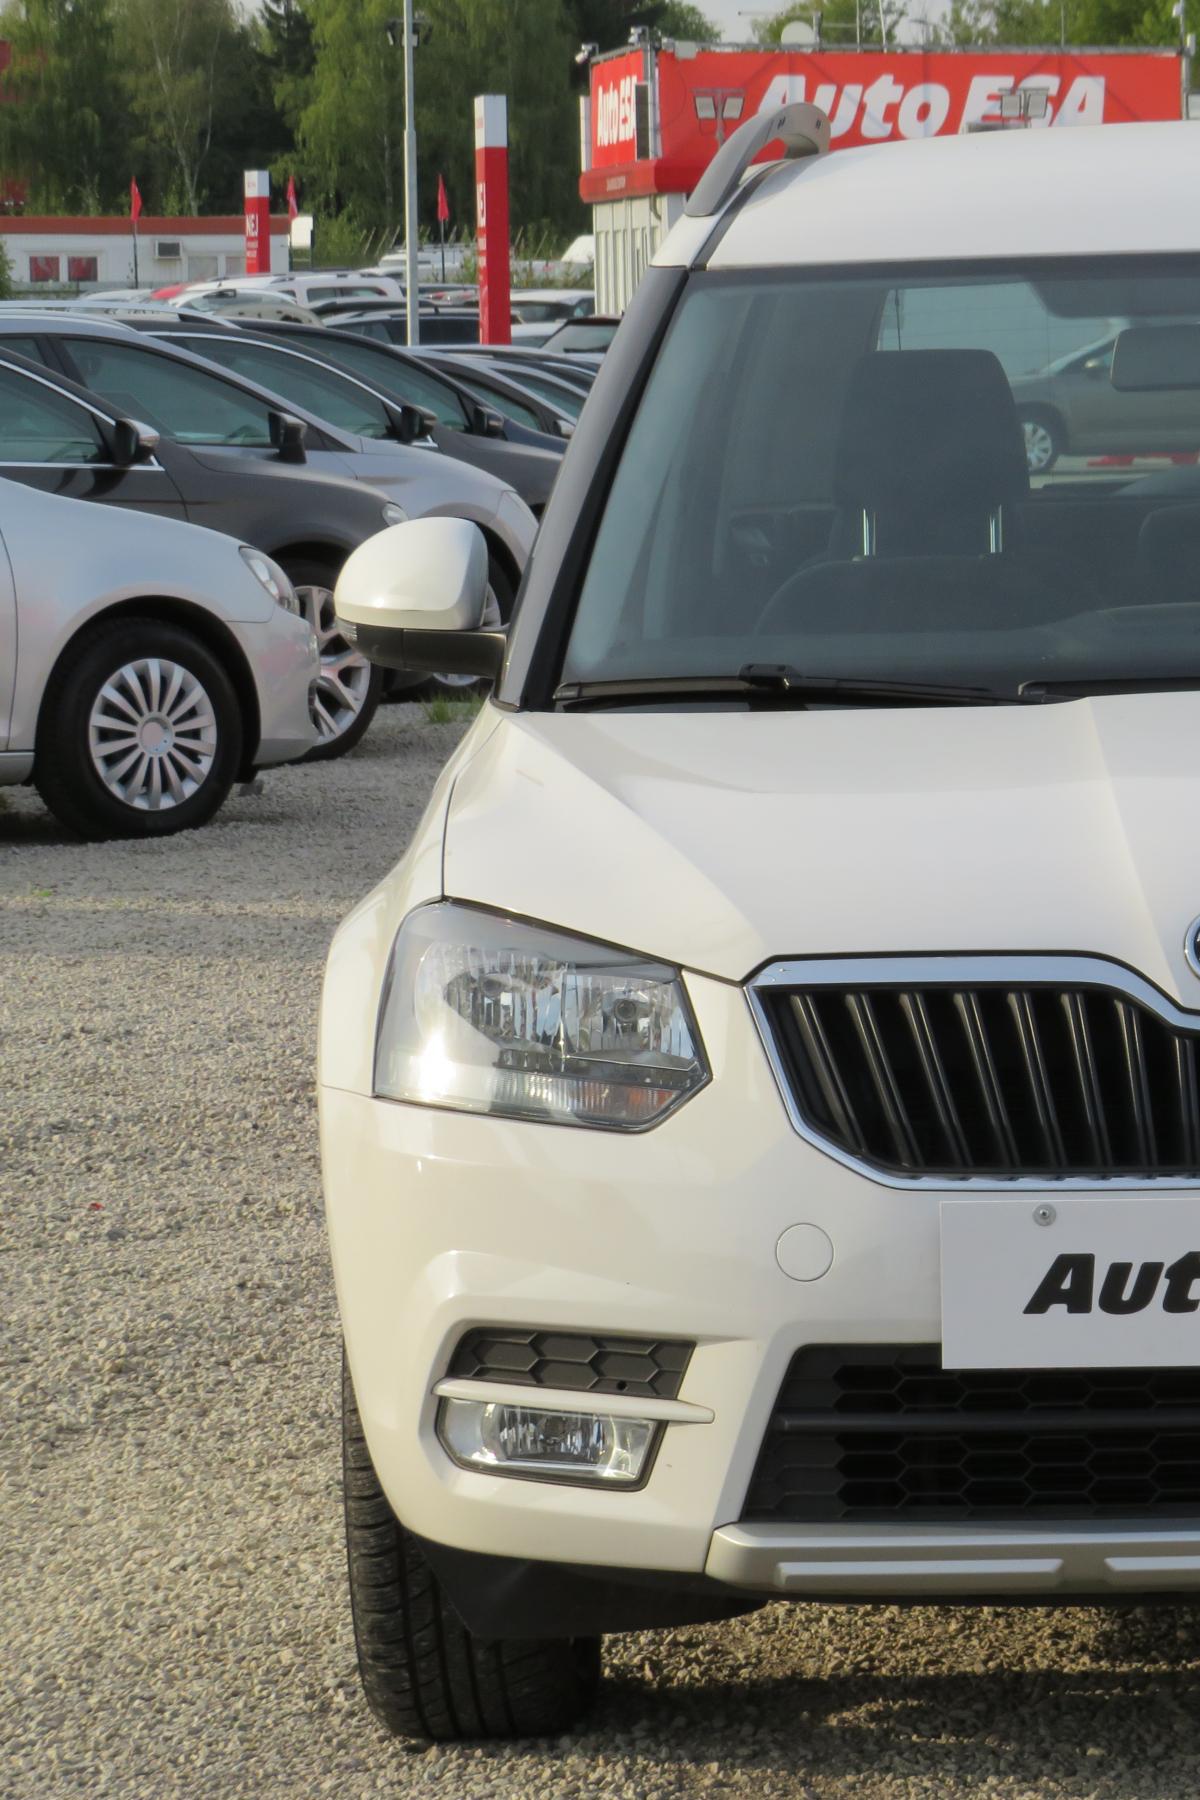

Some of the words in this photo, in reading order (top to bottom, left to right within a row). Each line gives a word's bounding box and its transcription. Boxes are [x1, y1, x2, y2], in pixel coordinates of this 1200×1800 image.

[597, 79, 619, 148] Auto
[755, 73, 951, 139] Auto
[958, 74, 1106, 135] ESA
